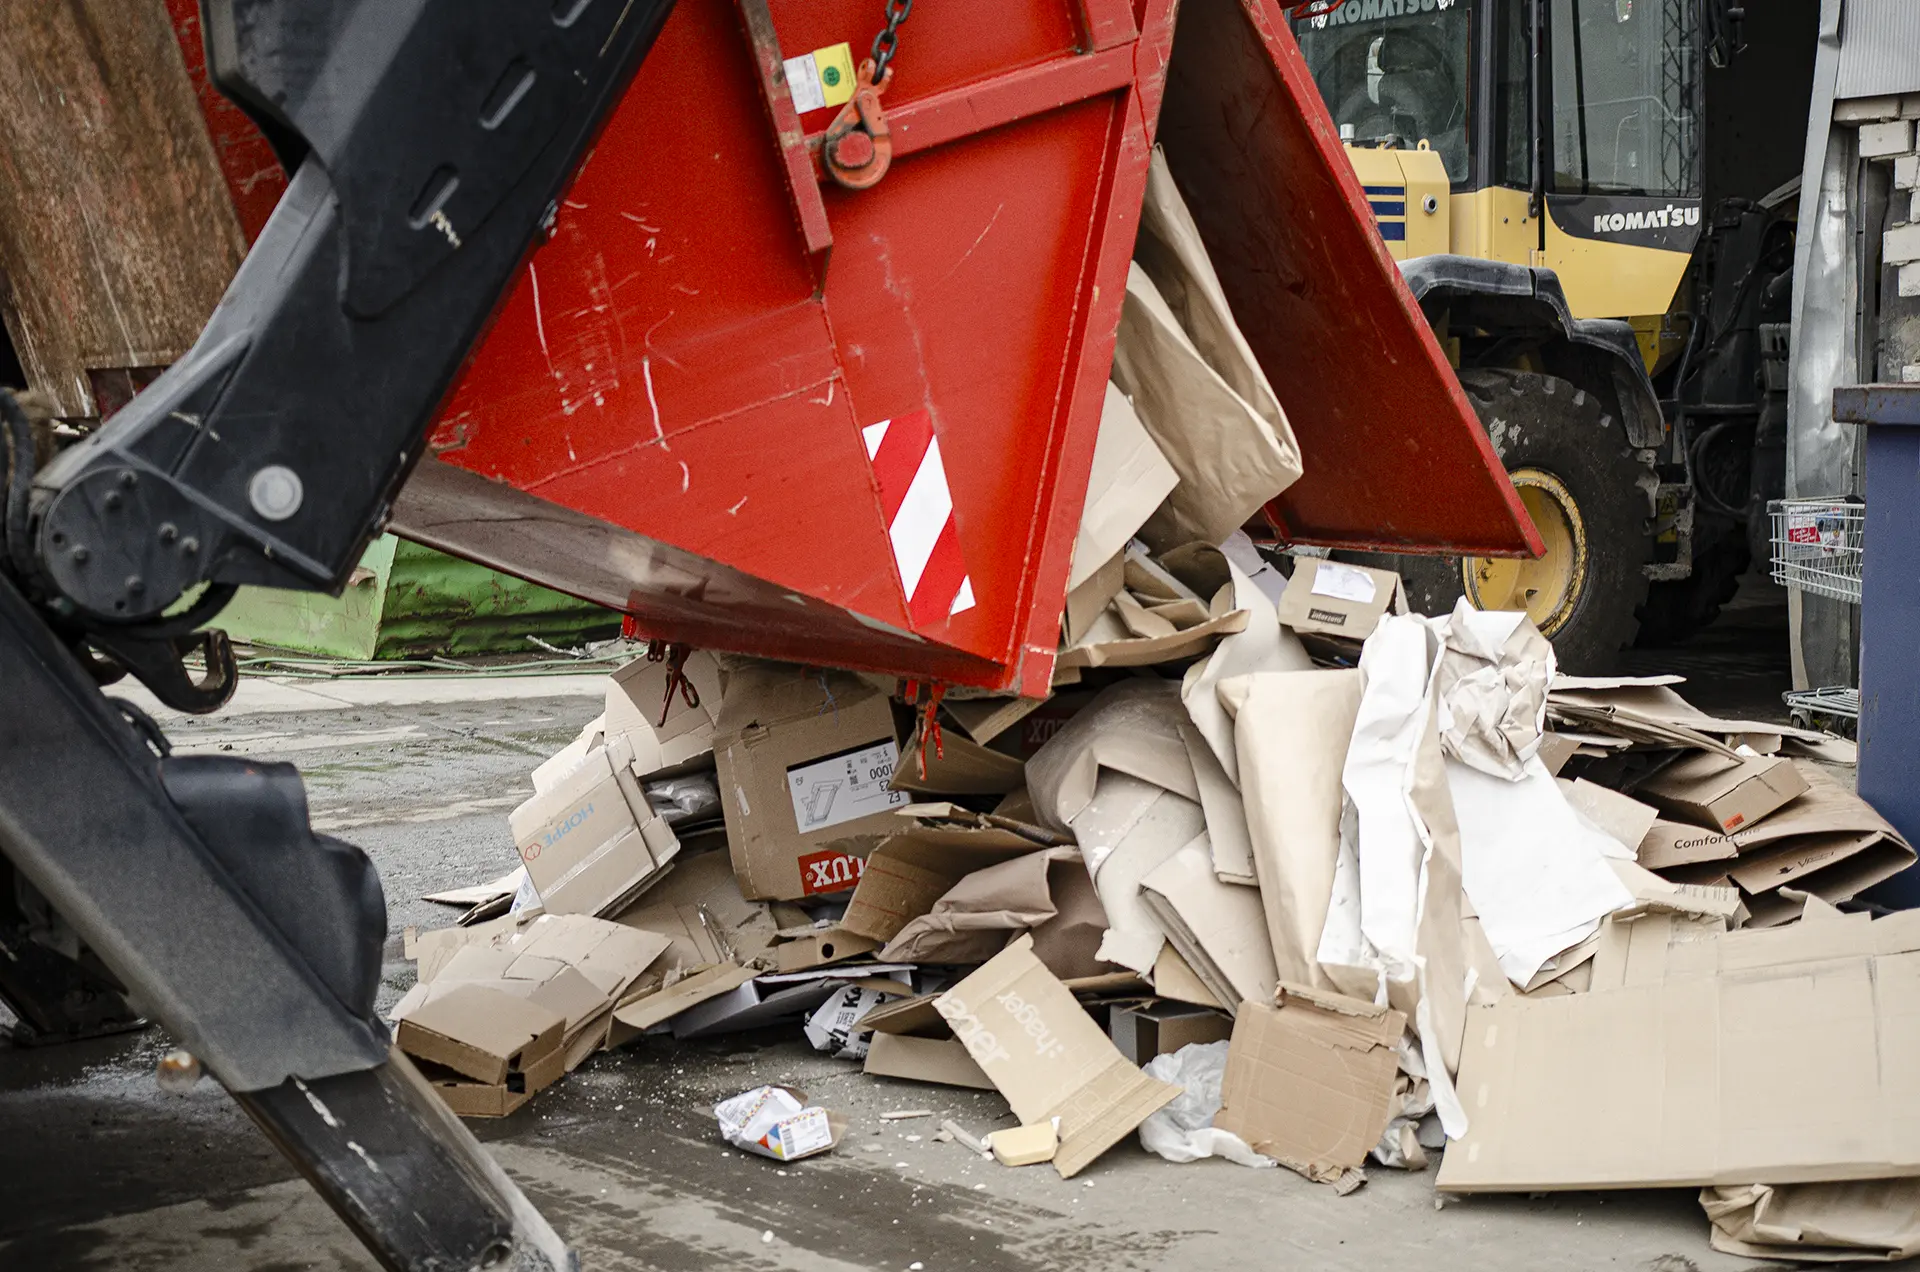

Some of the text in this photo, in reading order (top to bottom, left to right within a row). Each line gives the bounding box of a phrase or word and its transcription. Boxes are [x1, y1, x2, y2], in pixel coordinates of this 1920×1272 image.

[1330, 0, 1435, 26] KOMATSU
[1594, 204, 1700, 233] KOMATSU
[869, 763, 894, 780] 1000
[879, 779, 890, 792] 23
[542, 803, 594, 846] HOPPE
[810, 855, 865, 888] LUX
[931, 992, 1010, 1066] ager
